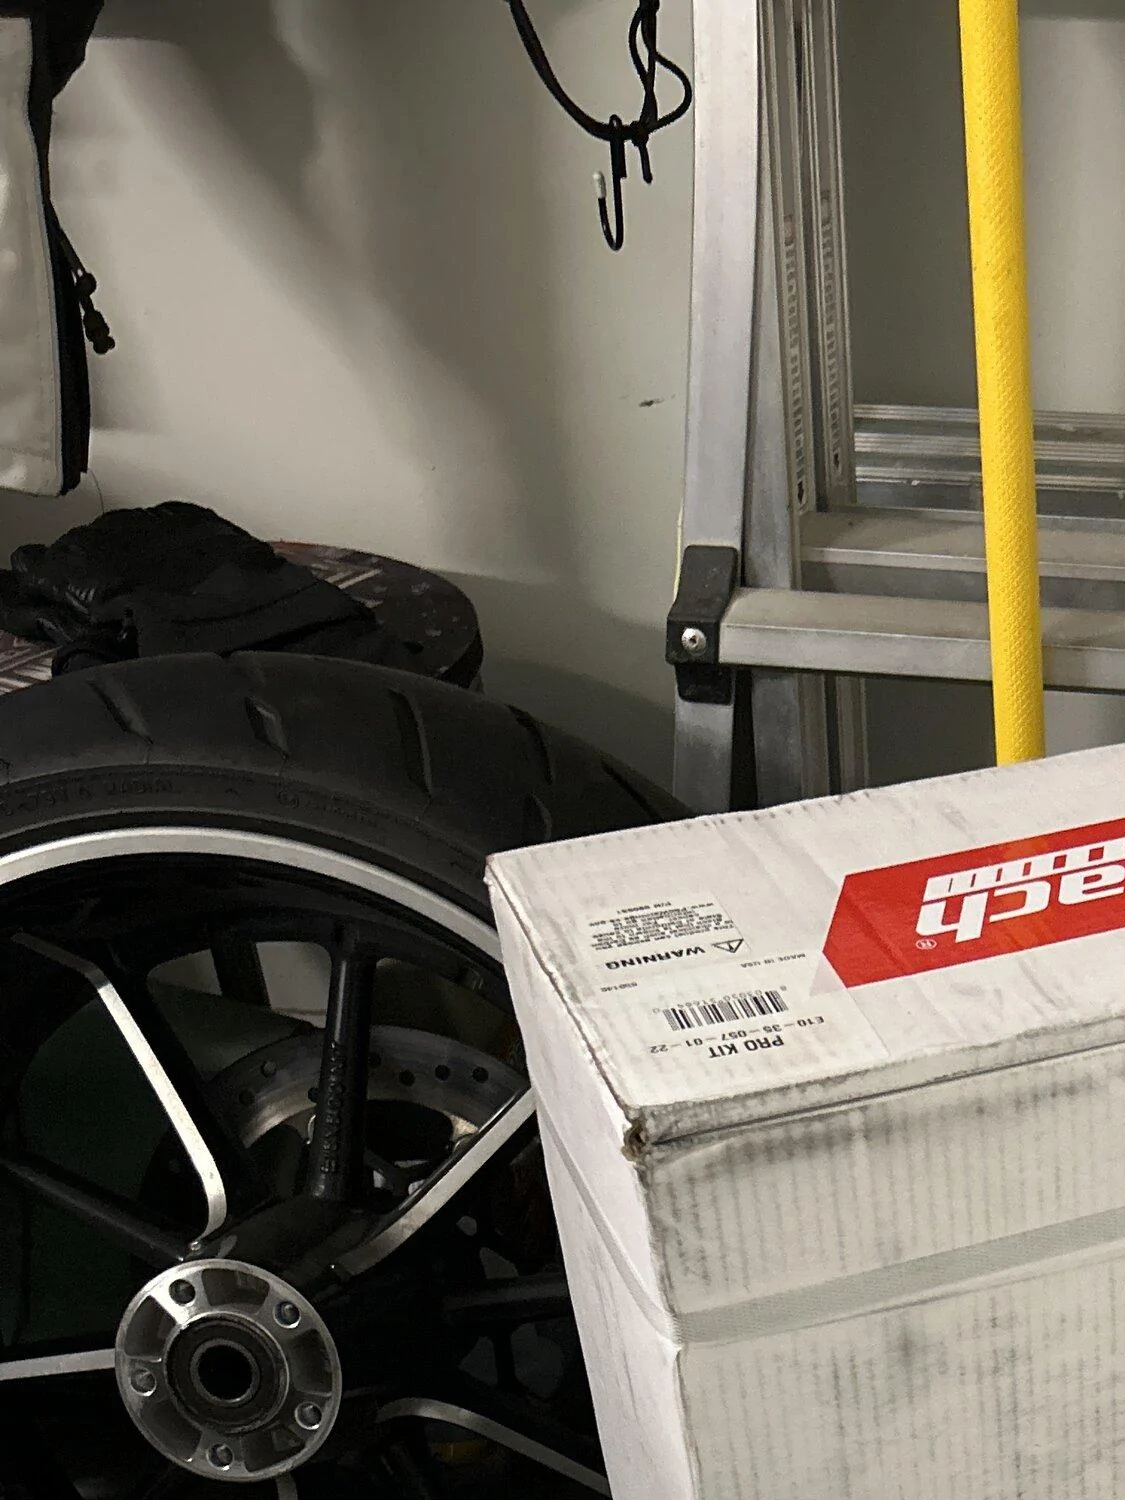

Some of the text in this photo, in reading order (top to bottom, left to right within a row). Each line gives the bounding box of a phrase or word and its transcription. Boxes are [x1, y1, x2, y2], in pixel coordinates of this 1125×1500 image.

[605, 946, 706, 970] WARNING
[708, 1034, 785, 1058] PRO KIT
